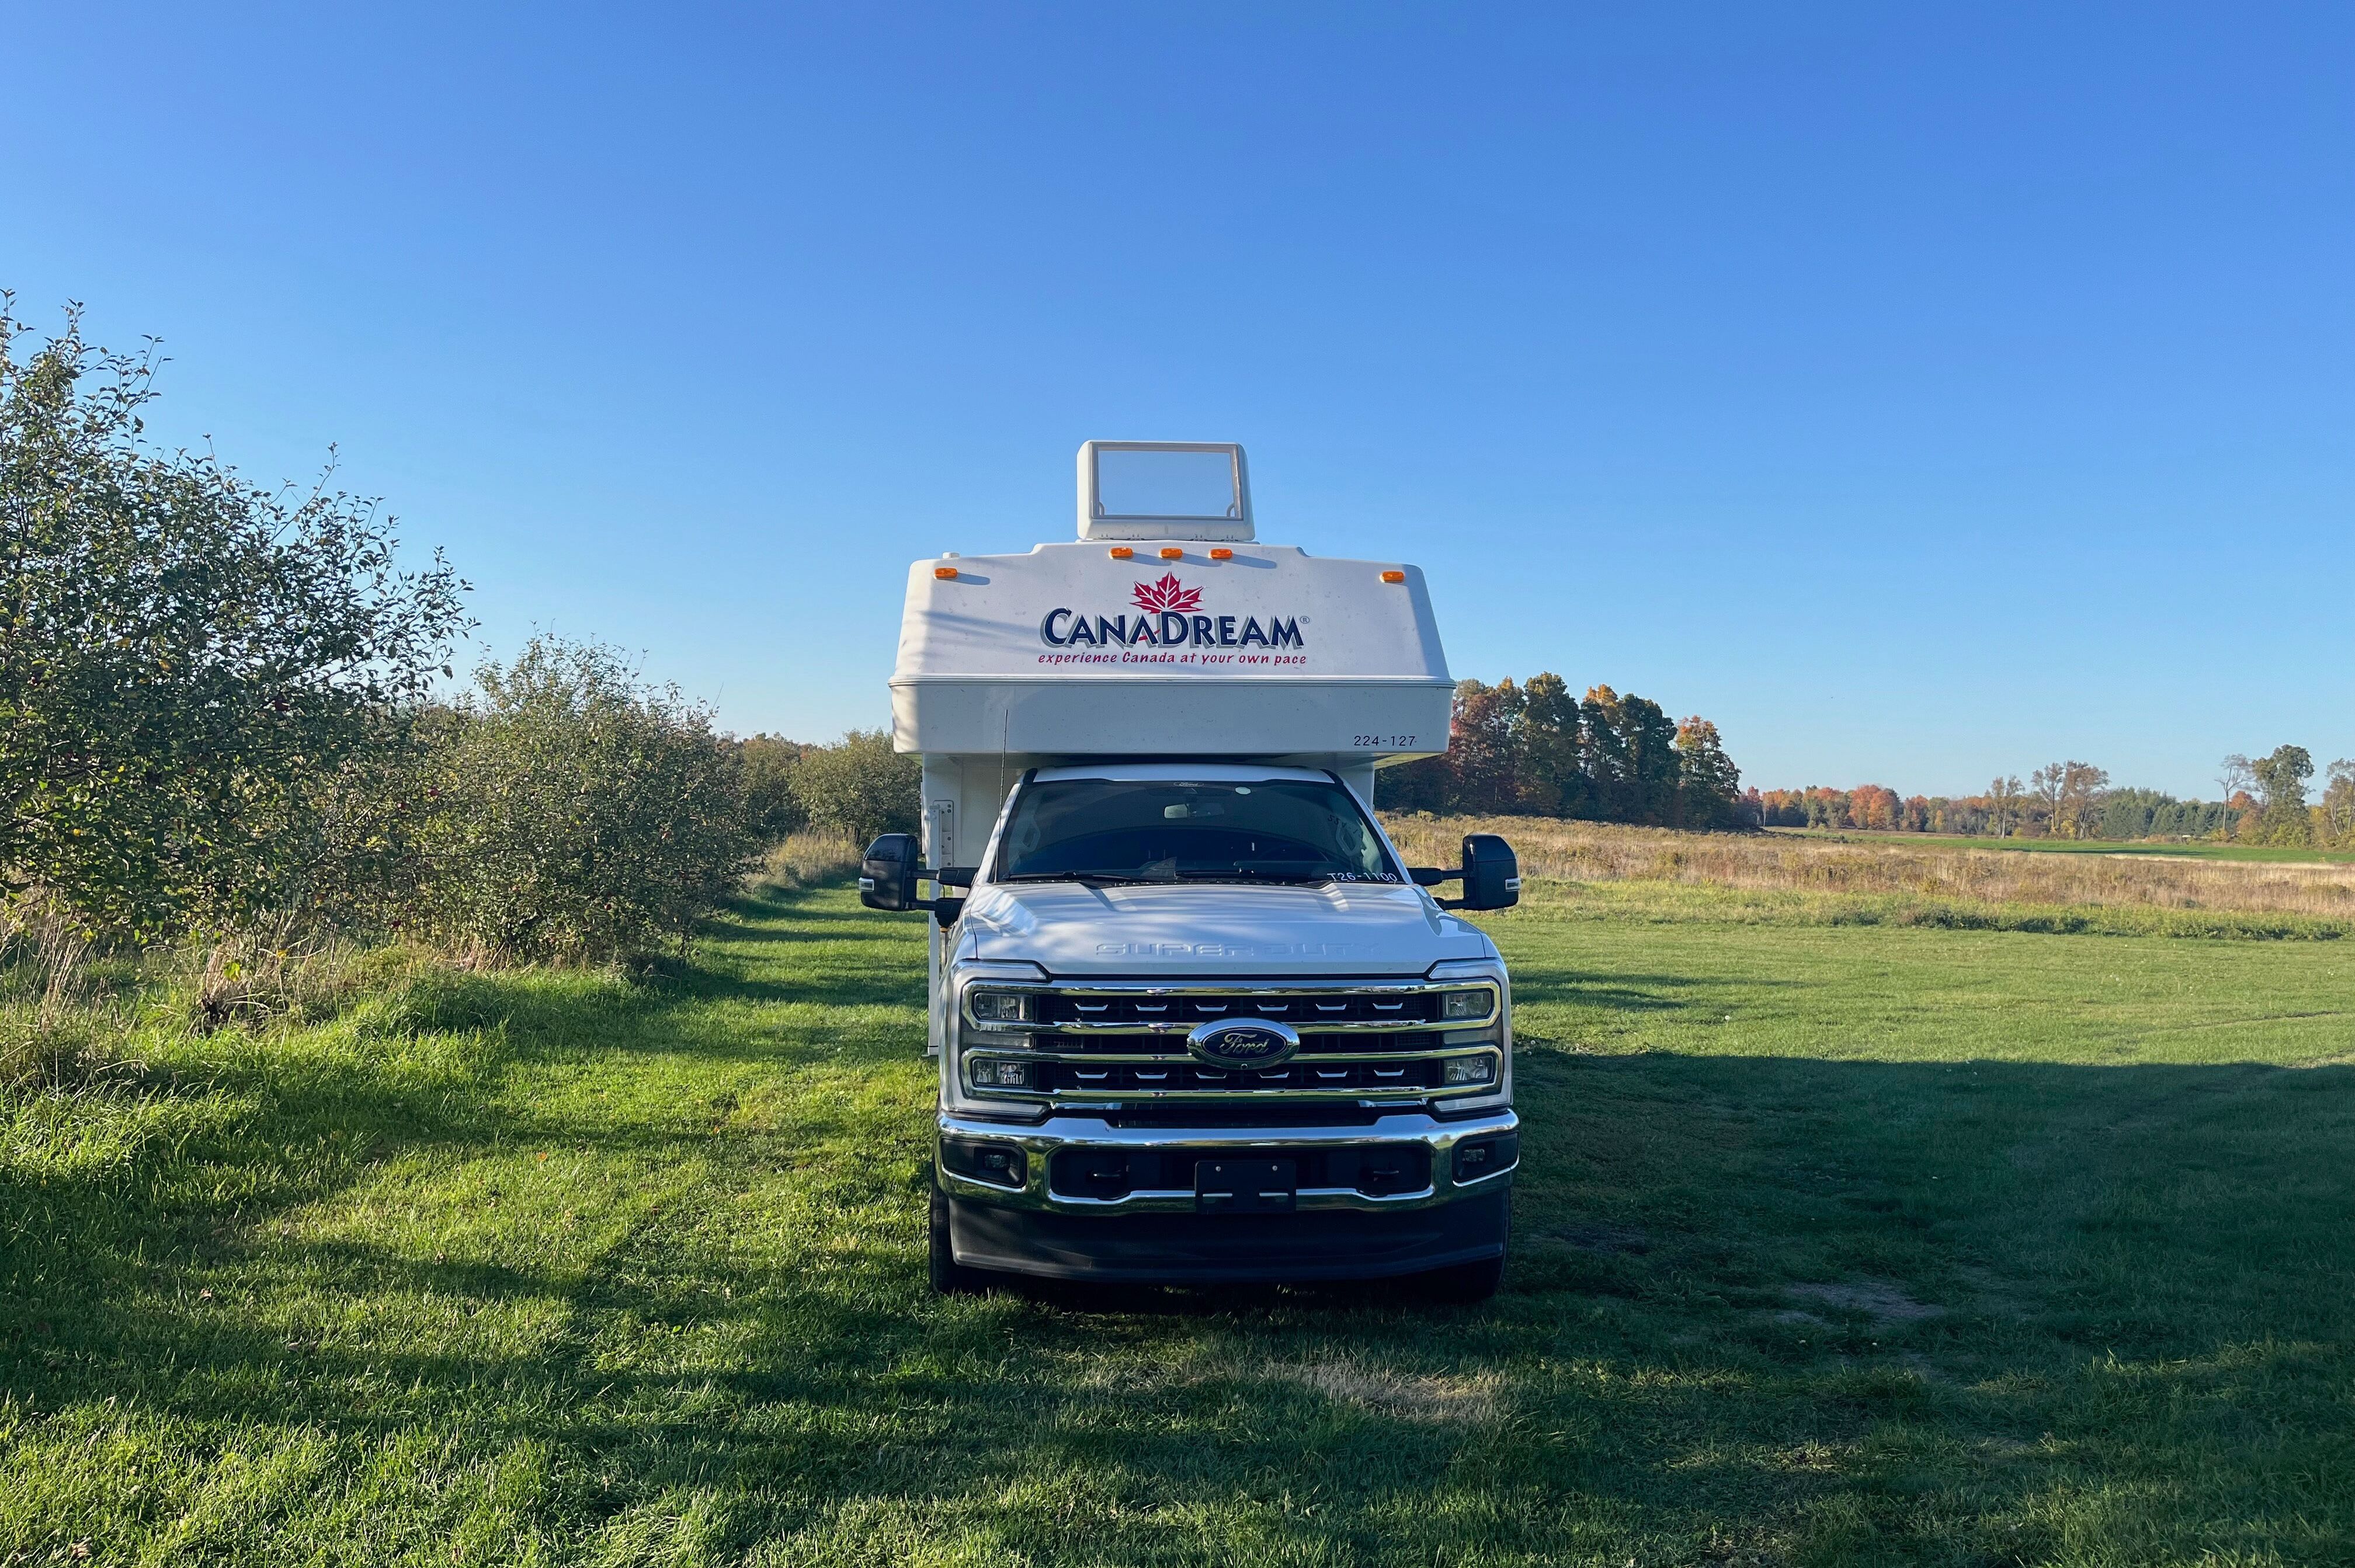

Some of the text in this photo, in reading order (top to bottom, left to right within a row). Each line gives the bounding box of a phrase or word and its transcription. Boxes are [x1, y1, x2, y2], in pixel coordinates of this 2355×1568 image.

[1038, 651, 1307, 666] experience Canada at your own pace
[1353, 735, 1416, 746] 224-127
[1327, 872, 1398, 882] T26-1100
[1096, 943, 1379, 956] SUPER DUTY
[1219, 1032, 1270, 1054] Ford
